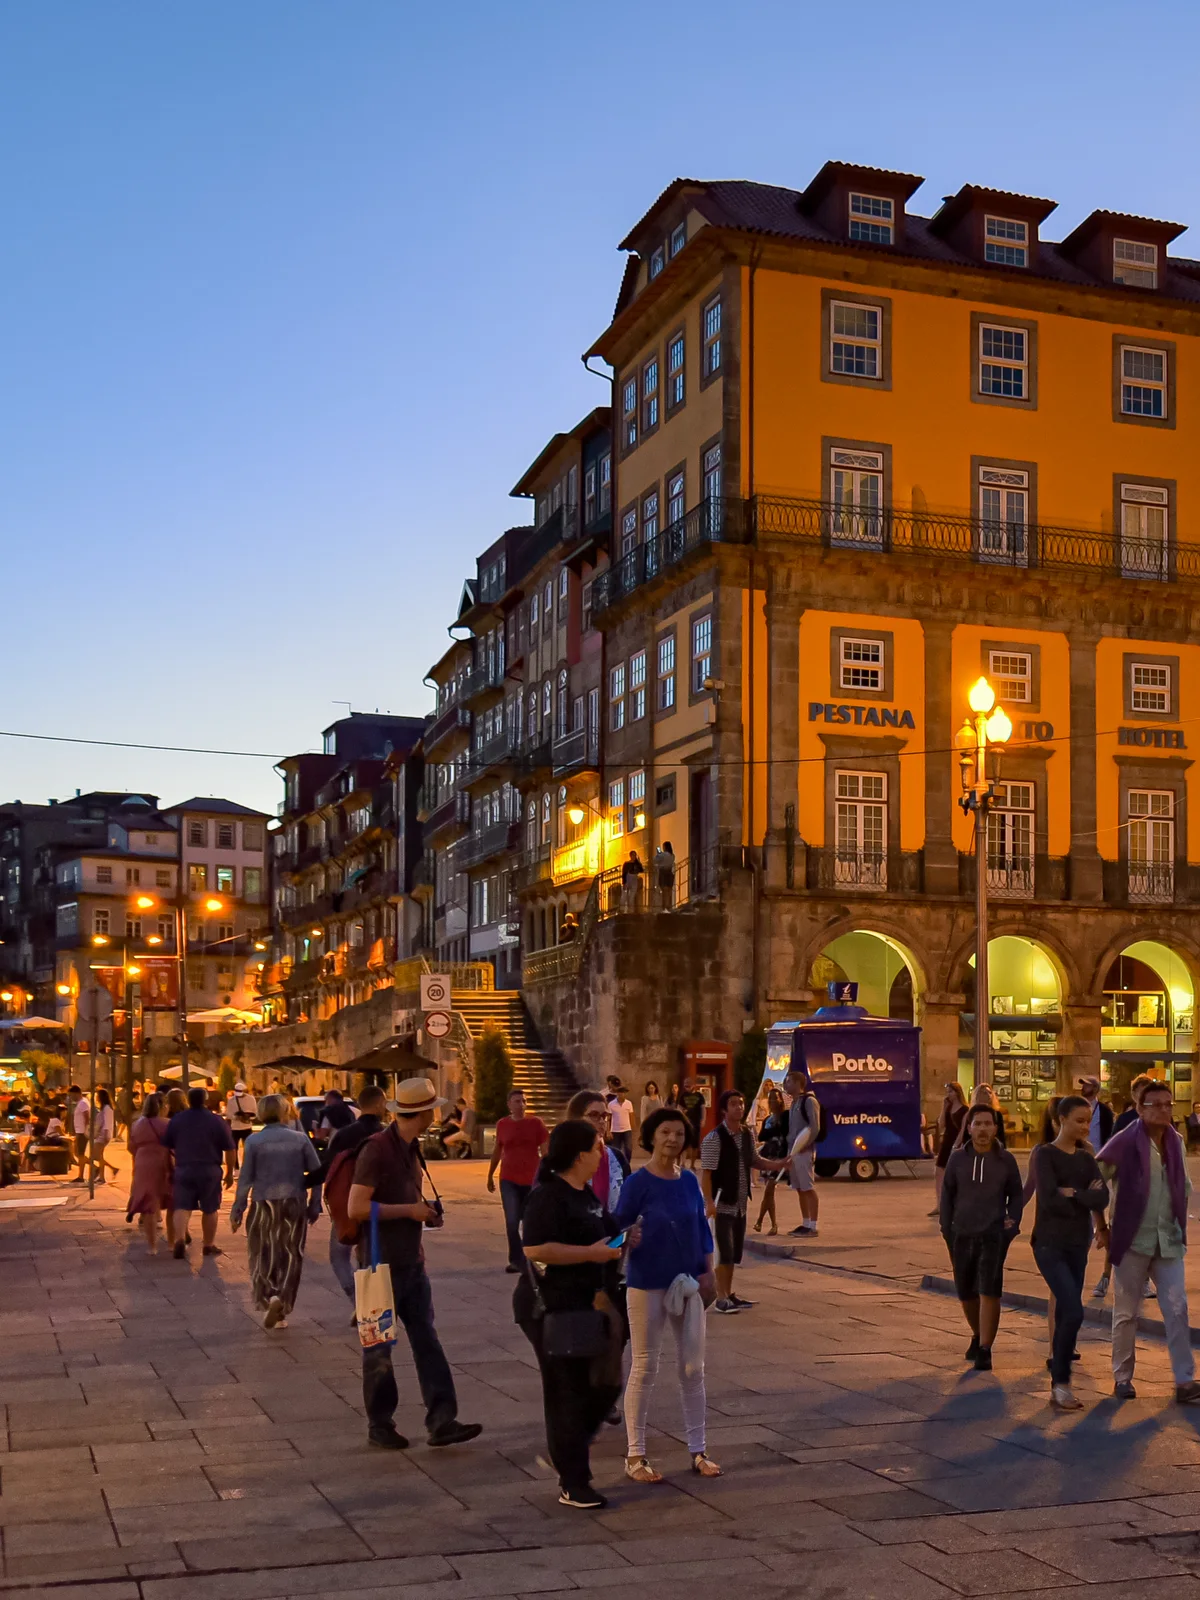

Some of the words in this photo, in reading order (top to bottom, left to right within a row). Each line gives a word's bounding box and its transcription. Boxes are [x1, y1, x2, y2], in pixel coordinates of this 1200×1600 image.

[809, 703, 915, 729] PESTANA
[1118, 726, 1187, 749] HOTEL
[430, 989, 442, 997] 20
[832, 1053, 893, 1071] Porto.
[860, 1113, 892, 1124] Porto.
